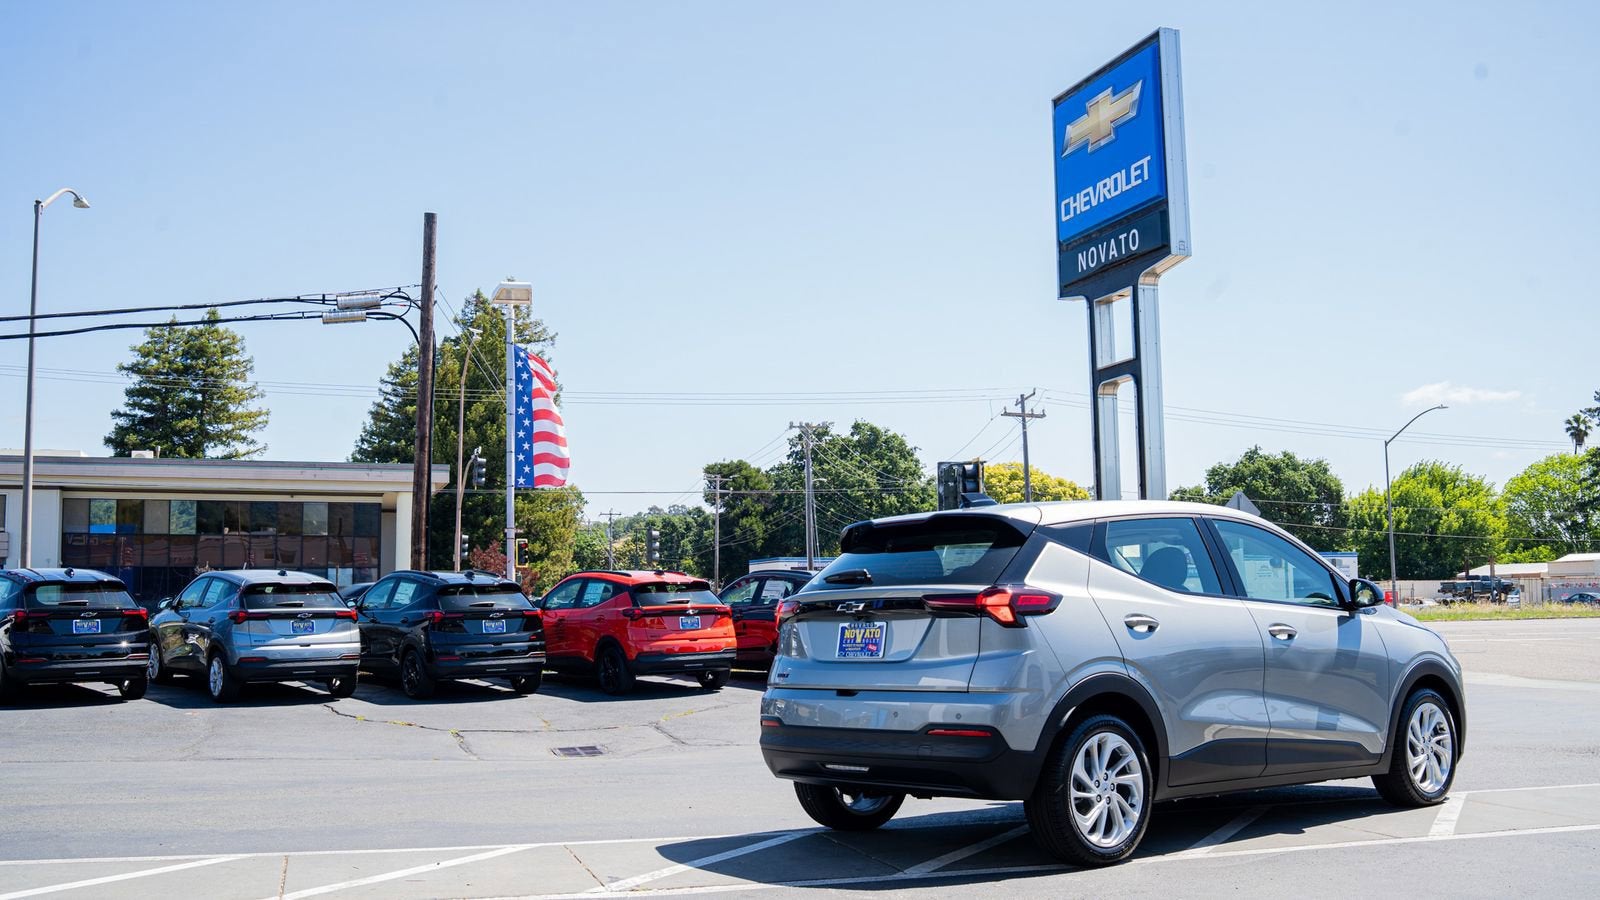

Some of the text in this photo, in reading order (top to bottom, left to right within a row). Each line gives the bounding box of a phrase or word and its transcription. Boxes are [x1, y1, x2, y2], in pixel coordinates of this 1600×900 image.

[1061, 155, 1151, 222] CHEVROLET
[1078, 228, 1139, 272] NOVATO
[844, 628, 881, 643] NOVATO
